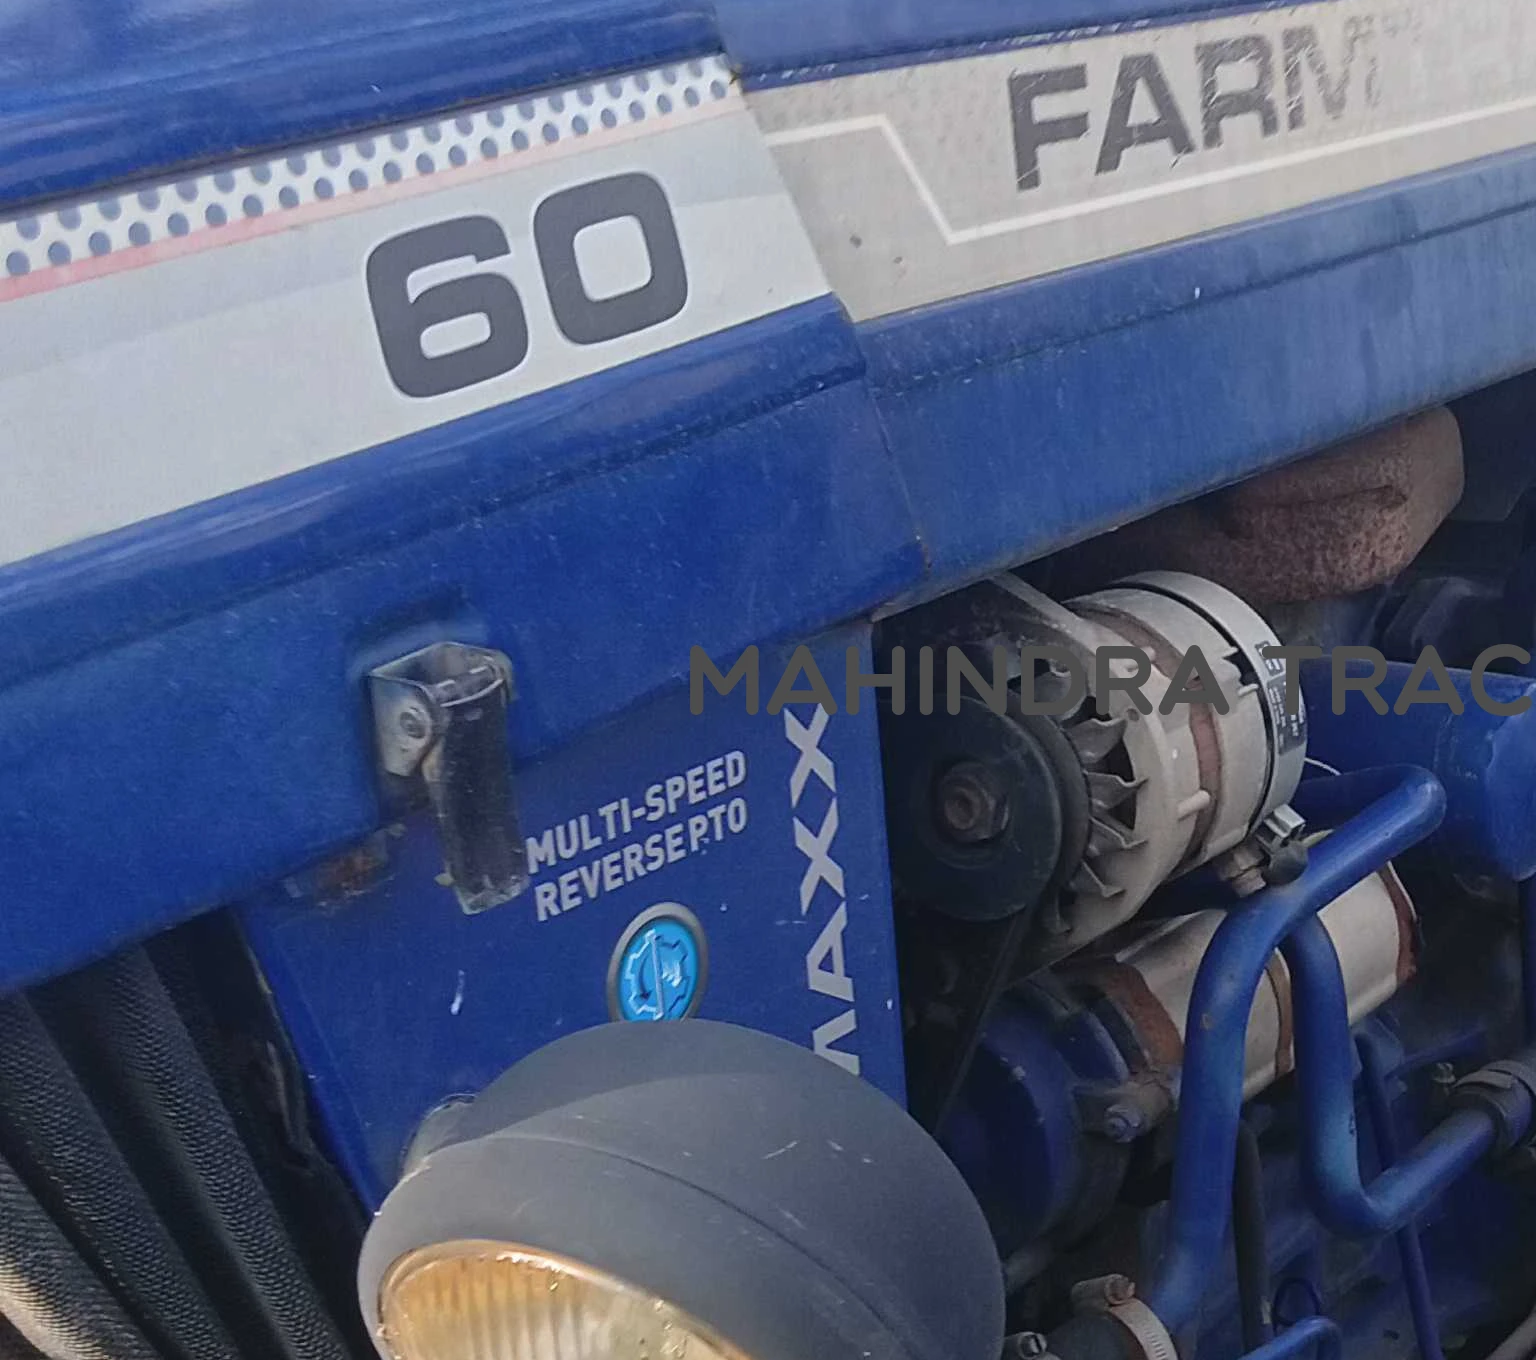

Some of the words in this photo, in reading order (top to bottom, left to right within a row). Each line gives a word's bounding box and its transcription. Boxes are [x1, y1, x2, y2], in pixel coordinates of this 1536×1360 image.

[366, 171, 688, 398] 60
[525, 749, 747, 875] MULTI-SPEED
[534, 823, 686, 922] REVERSE
[688, 797, 748, 853] PTO
